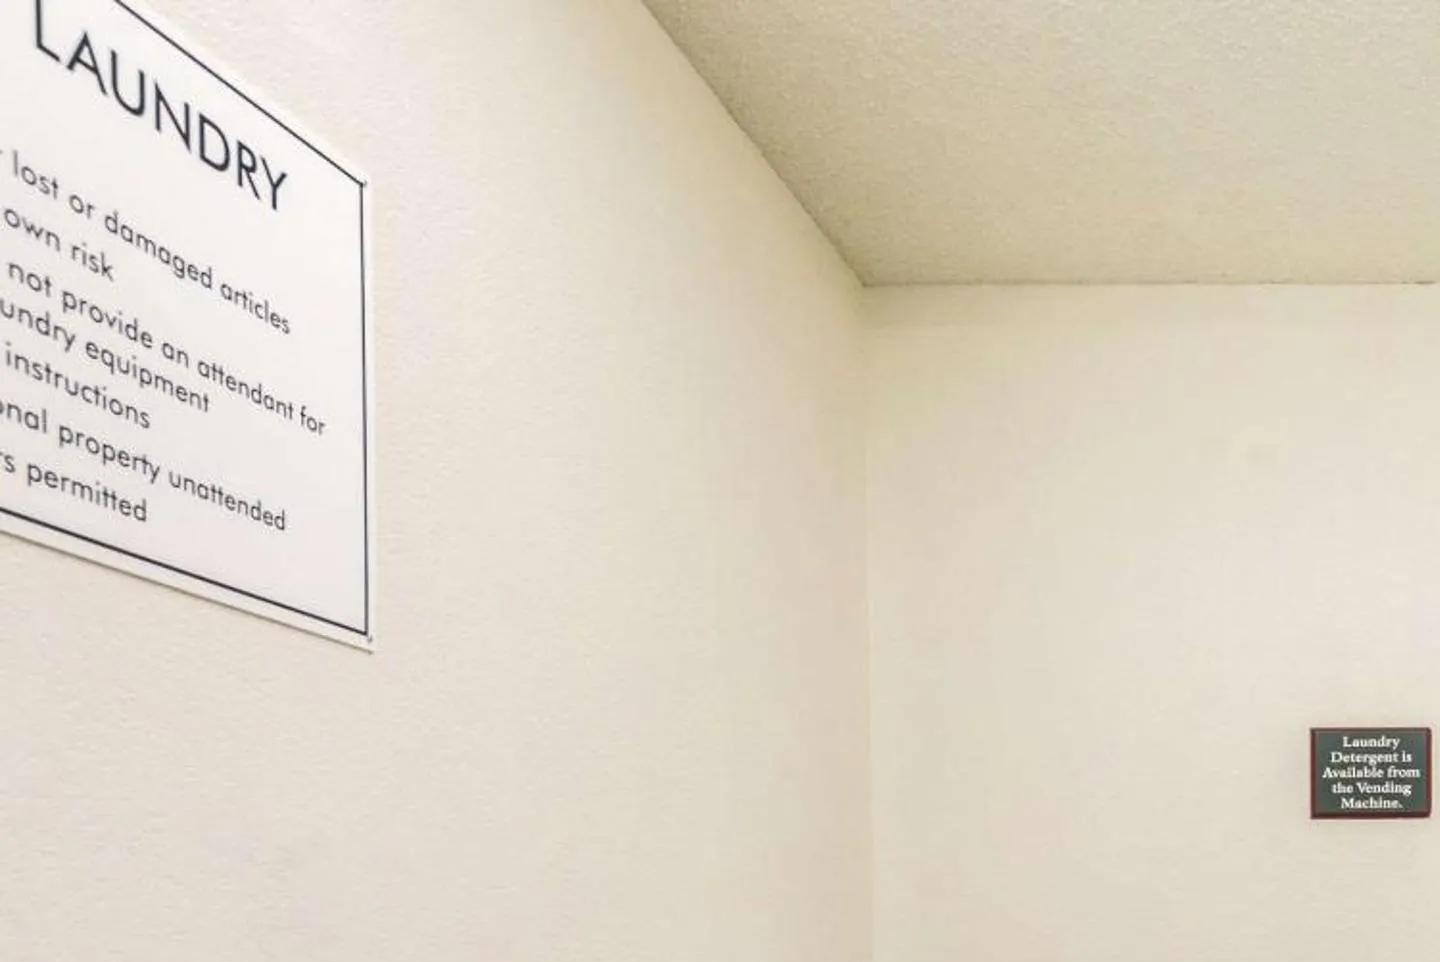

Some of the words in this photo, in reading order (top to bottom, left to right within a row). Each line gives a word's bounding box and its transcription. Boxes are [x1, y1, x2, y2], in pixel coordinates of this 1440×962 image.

[36, 0, 287, 211] LAUNDRY
[4, 208, 61, 252] own
[71, 241, 114, 282] risk
[12, 149, 59, 200] lost
[69, 193, 96, 219] or
[104, 210, 214, 290] damaged
[220, 282, 291, 334] articles
[5, 340, 151, 429] instructions
[8, 262, 52, 298] not
[62, 290, 153, 349] provide
[162, 342, 190, 368] an
[198, 360, 294, 420] attendant
[300, 405, 326, 435] for
[85, 341, 210, 413] equipment
[0, 401, 47, 434] nal
[59, 424, 160, 484] property
[168, 470, 286, 531] unattended
[27, 463, 148, 522] permitted
[1322, 766, 1384, 778] Available
[1387, 766, 1421, 778] from
[1331, 751, 1399, 766] Detergent
[1402, 750, 1412, 763] is
[1343, 735, 1400, 750] Laundry
[1332, 783, 1354, 794] the
[1356, 781, 1413, 797] Vending
[1341, 796, 1403, 809] Machine.
